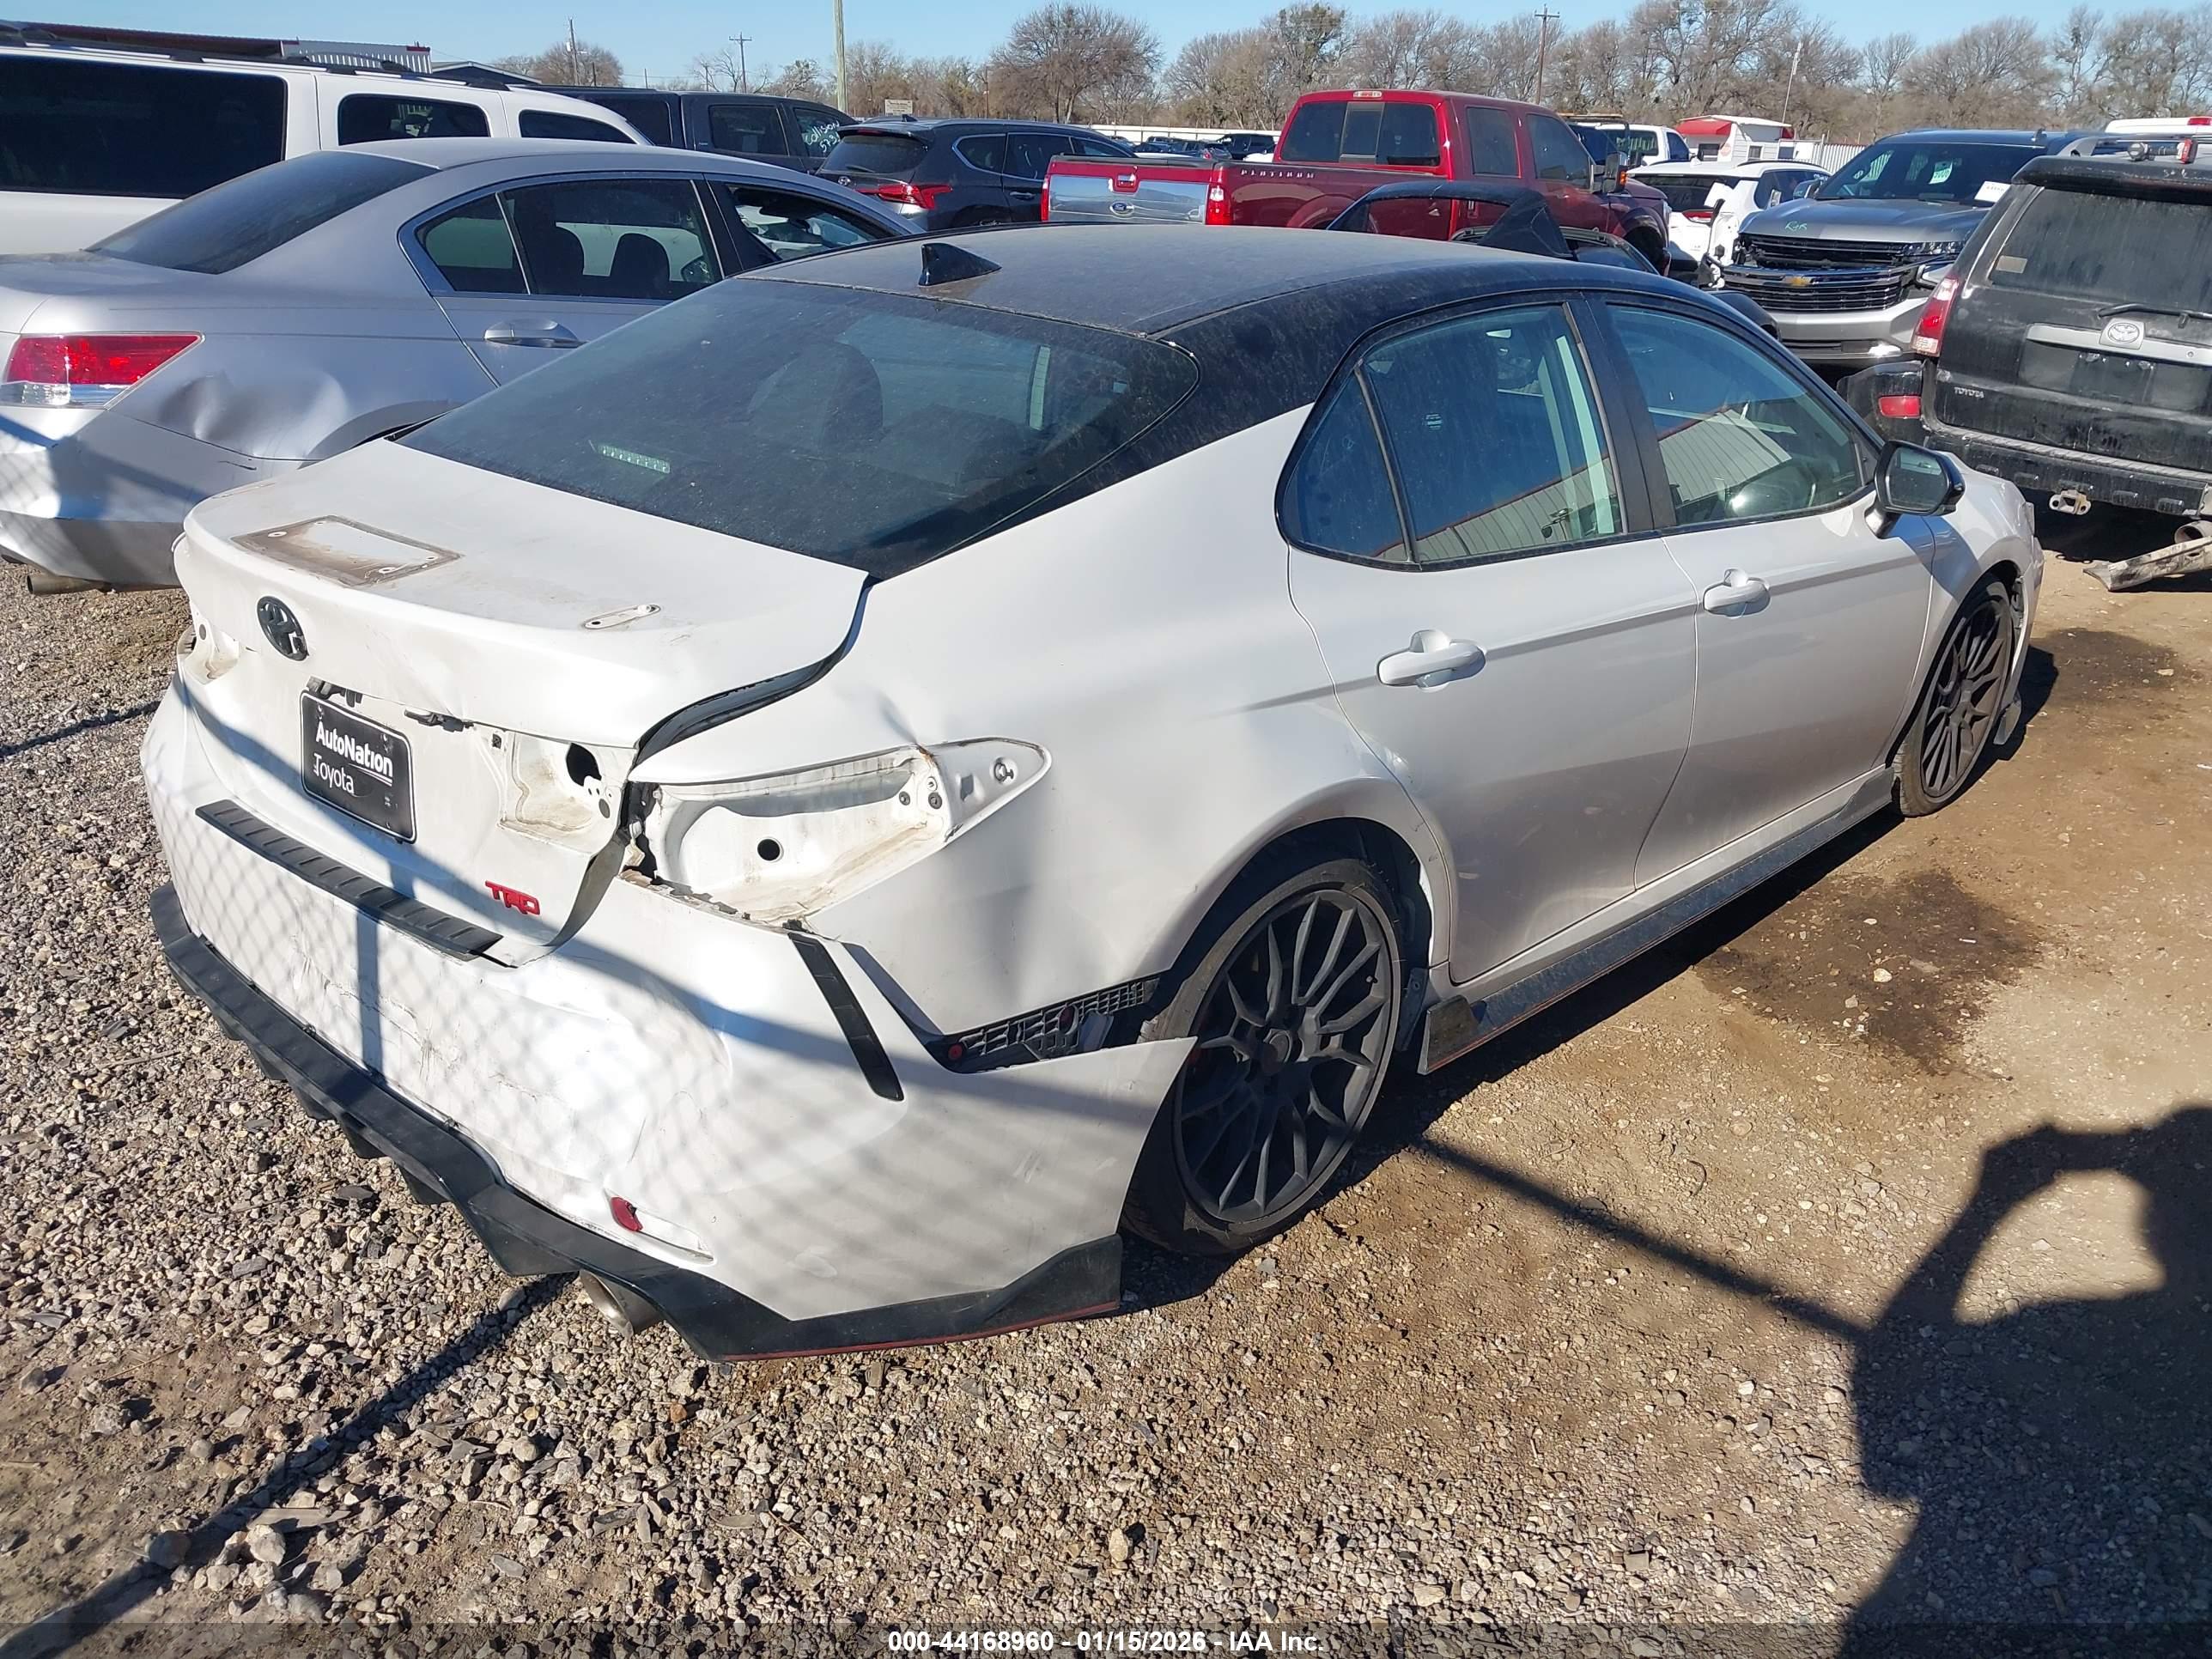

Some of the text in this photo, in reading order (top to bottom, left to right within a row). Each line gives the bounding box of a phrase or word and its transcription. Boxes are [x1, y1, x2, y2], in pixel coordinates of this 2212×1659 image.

[1954, 386, 1984, 398] TOYOTA
[315, 720, 393, 777] AutoNation
[313, 752, 355, 794] Toyota
[485, 880, 540, 915] TRD
